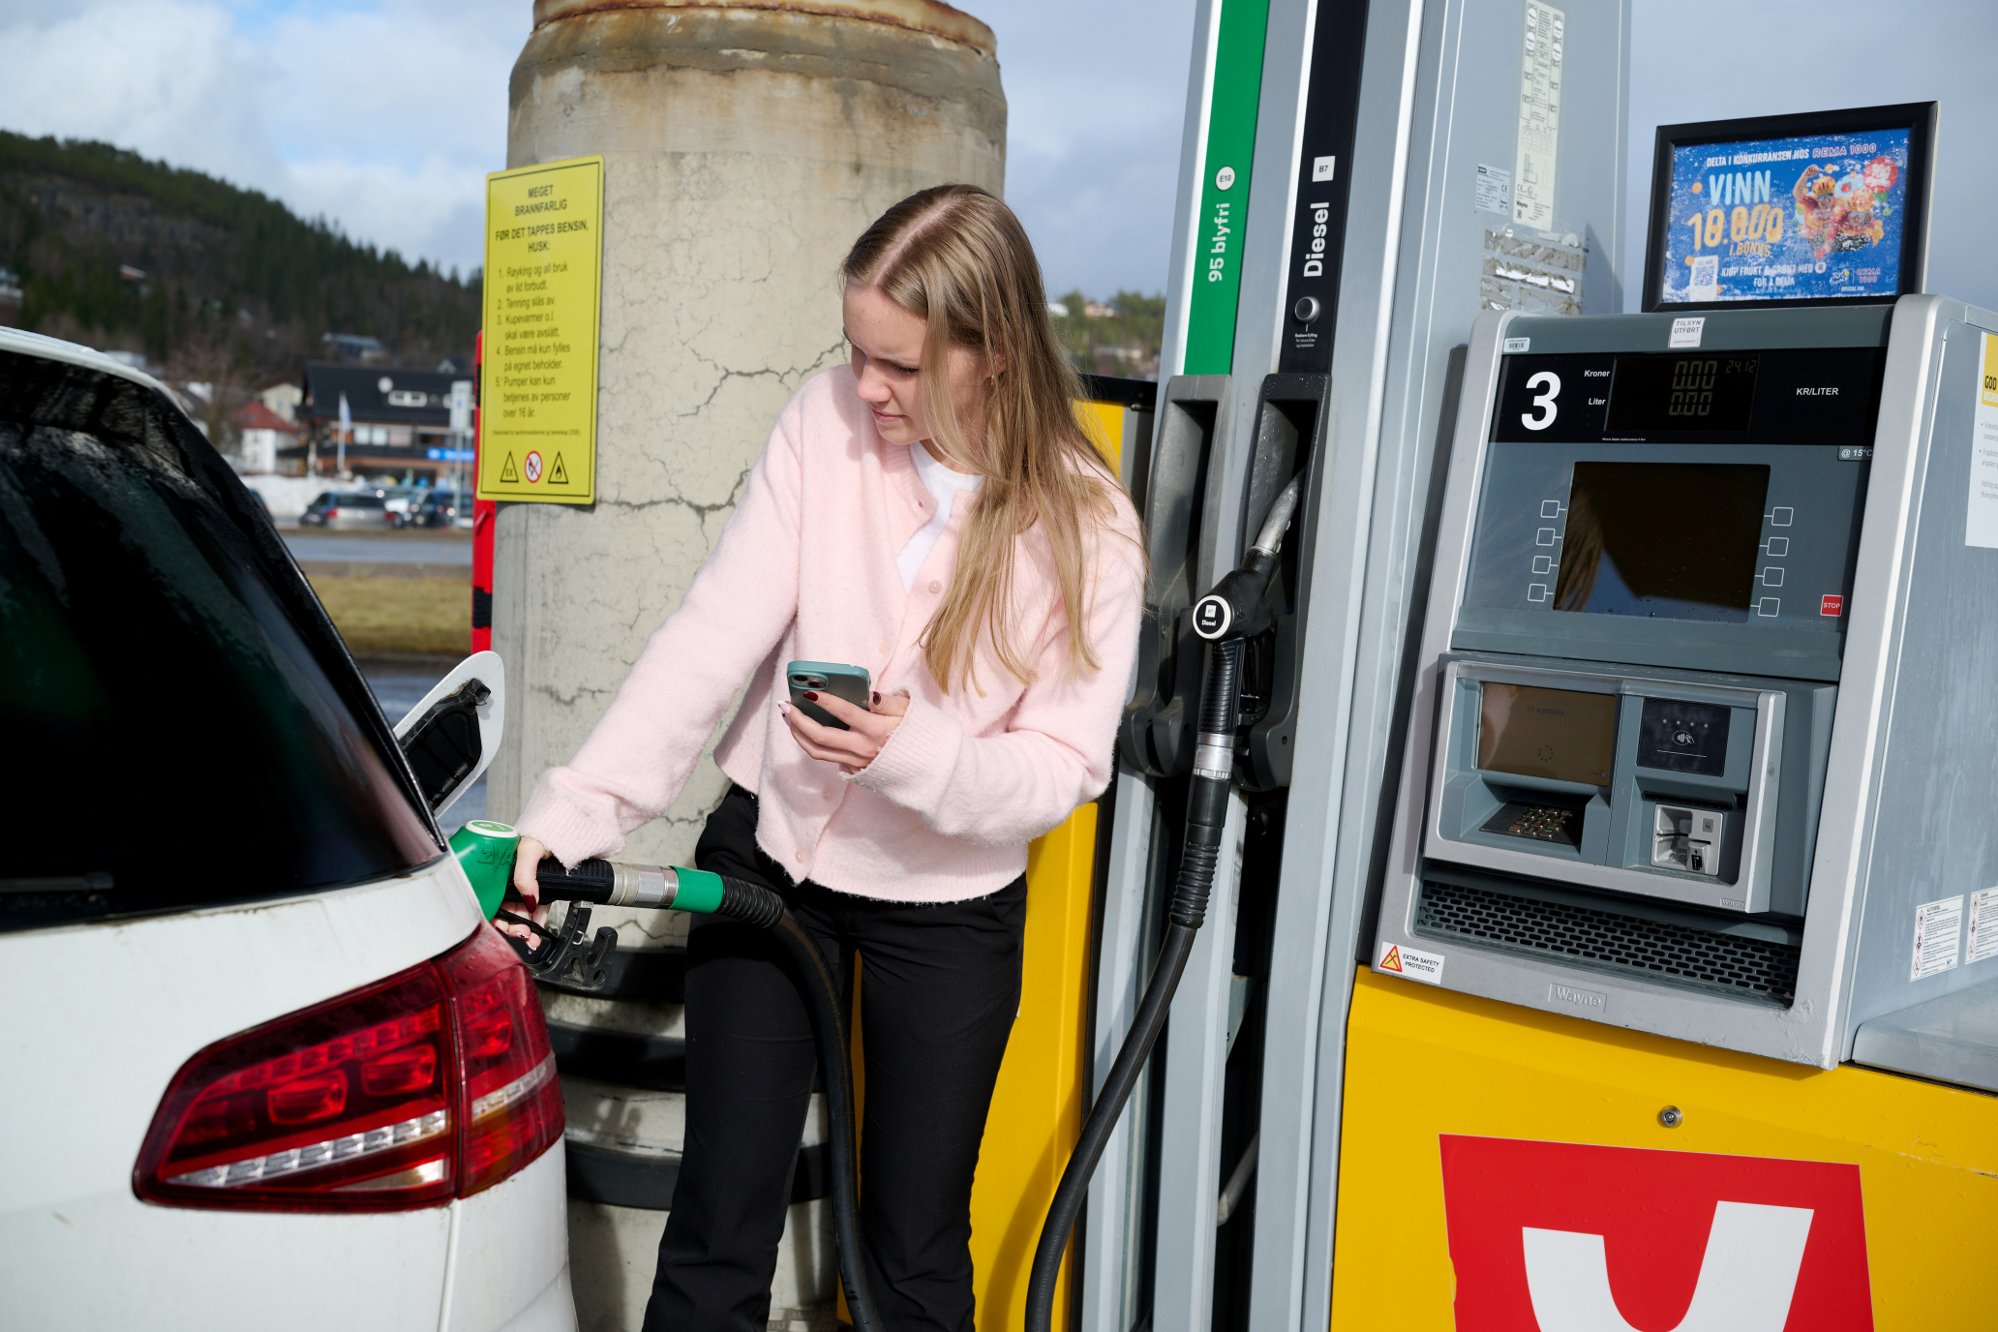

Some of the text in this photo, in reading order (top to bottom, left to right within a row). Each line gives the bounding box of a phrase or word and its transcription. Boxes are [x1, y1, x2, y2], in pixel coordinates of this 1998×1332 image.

[1706, 156, 1727, 168] DELTA
[1793, 149, 1810, 160] HOS
[1812, 146, 1847, 159] REMA
[1850, 142, 1877, 156] 1000
[1318, 165, 1329, 174] B7
[1219, 174, 1232, 183] E10
[528, 184, 554, 198] MEGET
[1709, 170, 1771, 206] VINN
[515, 199, 568, 217] BRANNFARLIG
[496, 229, 510, 241] FØR
[512, 227, 526, 240] DET
[527, 223, 556, 237] TAPPES
[1687, 204, 1784, 251] 10.000
[528, 240, 551, 253] HUSK:
[1208, 202, 1231, 283] 95 blyfri
[1303, 202, 1330, 278] Diesel
[1736, 241, 1772, 256] BONUS
[506, 266, 533, 279] Røyking
[534, 266, 543, 277] og
[544, 262, 553, 273] all
[553, 262, 568, 273] bruk
[1721, 266, 1739, 277] KJØP
[1740, 265, 1763, 276] FRUKT
[506, 279, 548, 293] av ild forbudt.
[1754, 277, 1767, 288] FOR
[506, 298, 531, 311] Tenning
[532, 297, 546, 308] slås
[546, 297, 555, 306] av
[506, 313, 544, 328] Kupevarmer
[505, 330, 519, 341] skal
[519, 330, 536, 340] være
[1673, 326, 1700, 334] UTFØRT
[504, 345, 527, 356] Bensin
[527, 344, 538, 354] må
[538, 343, 552, 354] kun
[552, 342, 571, 356] fylles
[504, 361, 514, 373] på
[514, 360, 532, 372] egnet
[1584, 369, 1611, 378] Kroner
[504, 376, 529, 388] Pumper
[529, 375, 542, 386] kan
[543, 374, 556, 386] kun
[503, 391, 571, 404] betjenes av personer
[1796, 387, 1839, 396] KR/LITER
[1521, 371, 1561, 431] 3
[1588, 397, 1606, 406] Liter
[503, 407, 517, 418] over
[519, 406, 526, 417] 16
[1840, 448, 1850, 458] @
[1201, 619, 1217, 627] Diesel
[1403, 953, 1440, 967] EXTRA SAFETY
[1405, 961, 1435, 973] PROTECTED
[1555, 987, 1601, 1008] Wayne
